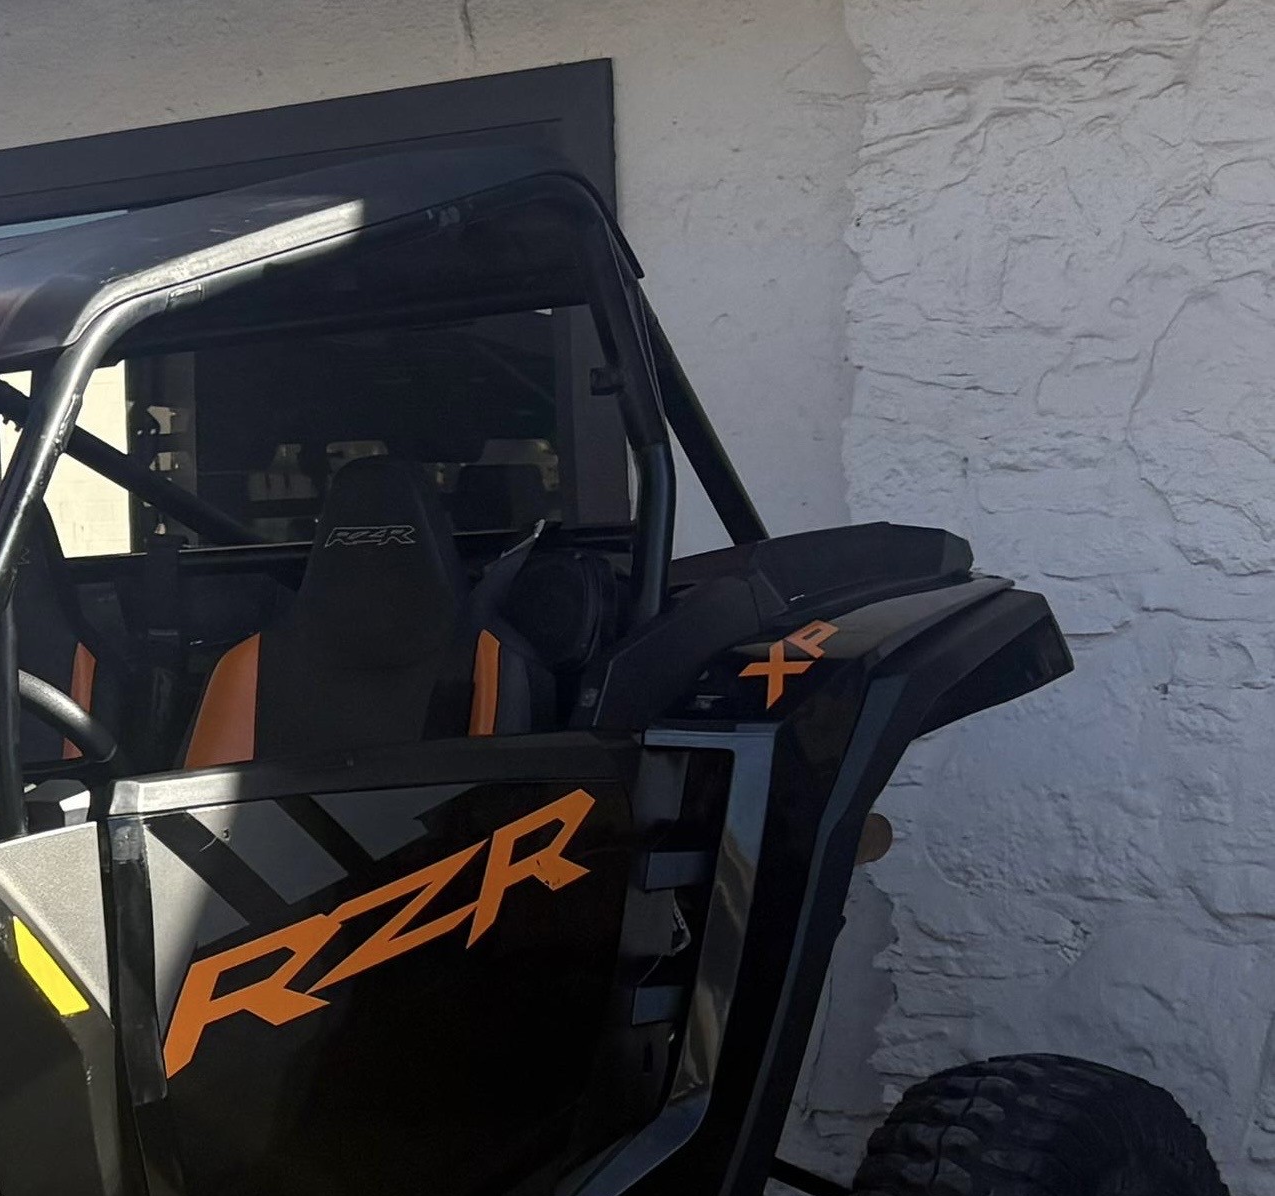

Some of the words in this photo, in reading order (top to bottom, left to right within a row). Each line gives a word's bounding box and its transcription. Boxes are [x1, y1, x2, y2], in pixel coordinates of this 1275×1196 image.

[325, 525, 416, 548] RZR
[737, 619, 839, 710] XP
[163, 788, 596, 1080] RZR
